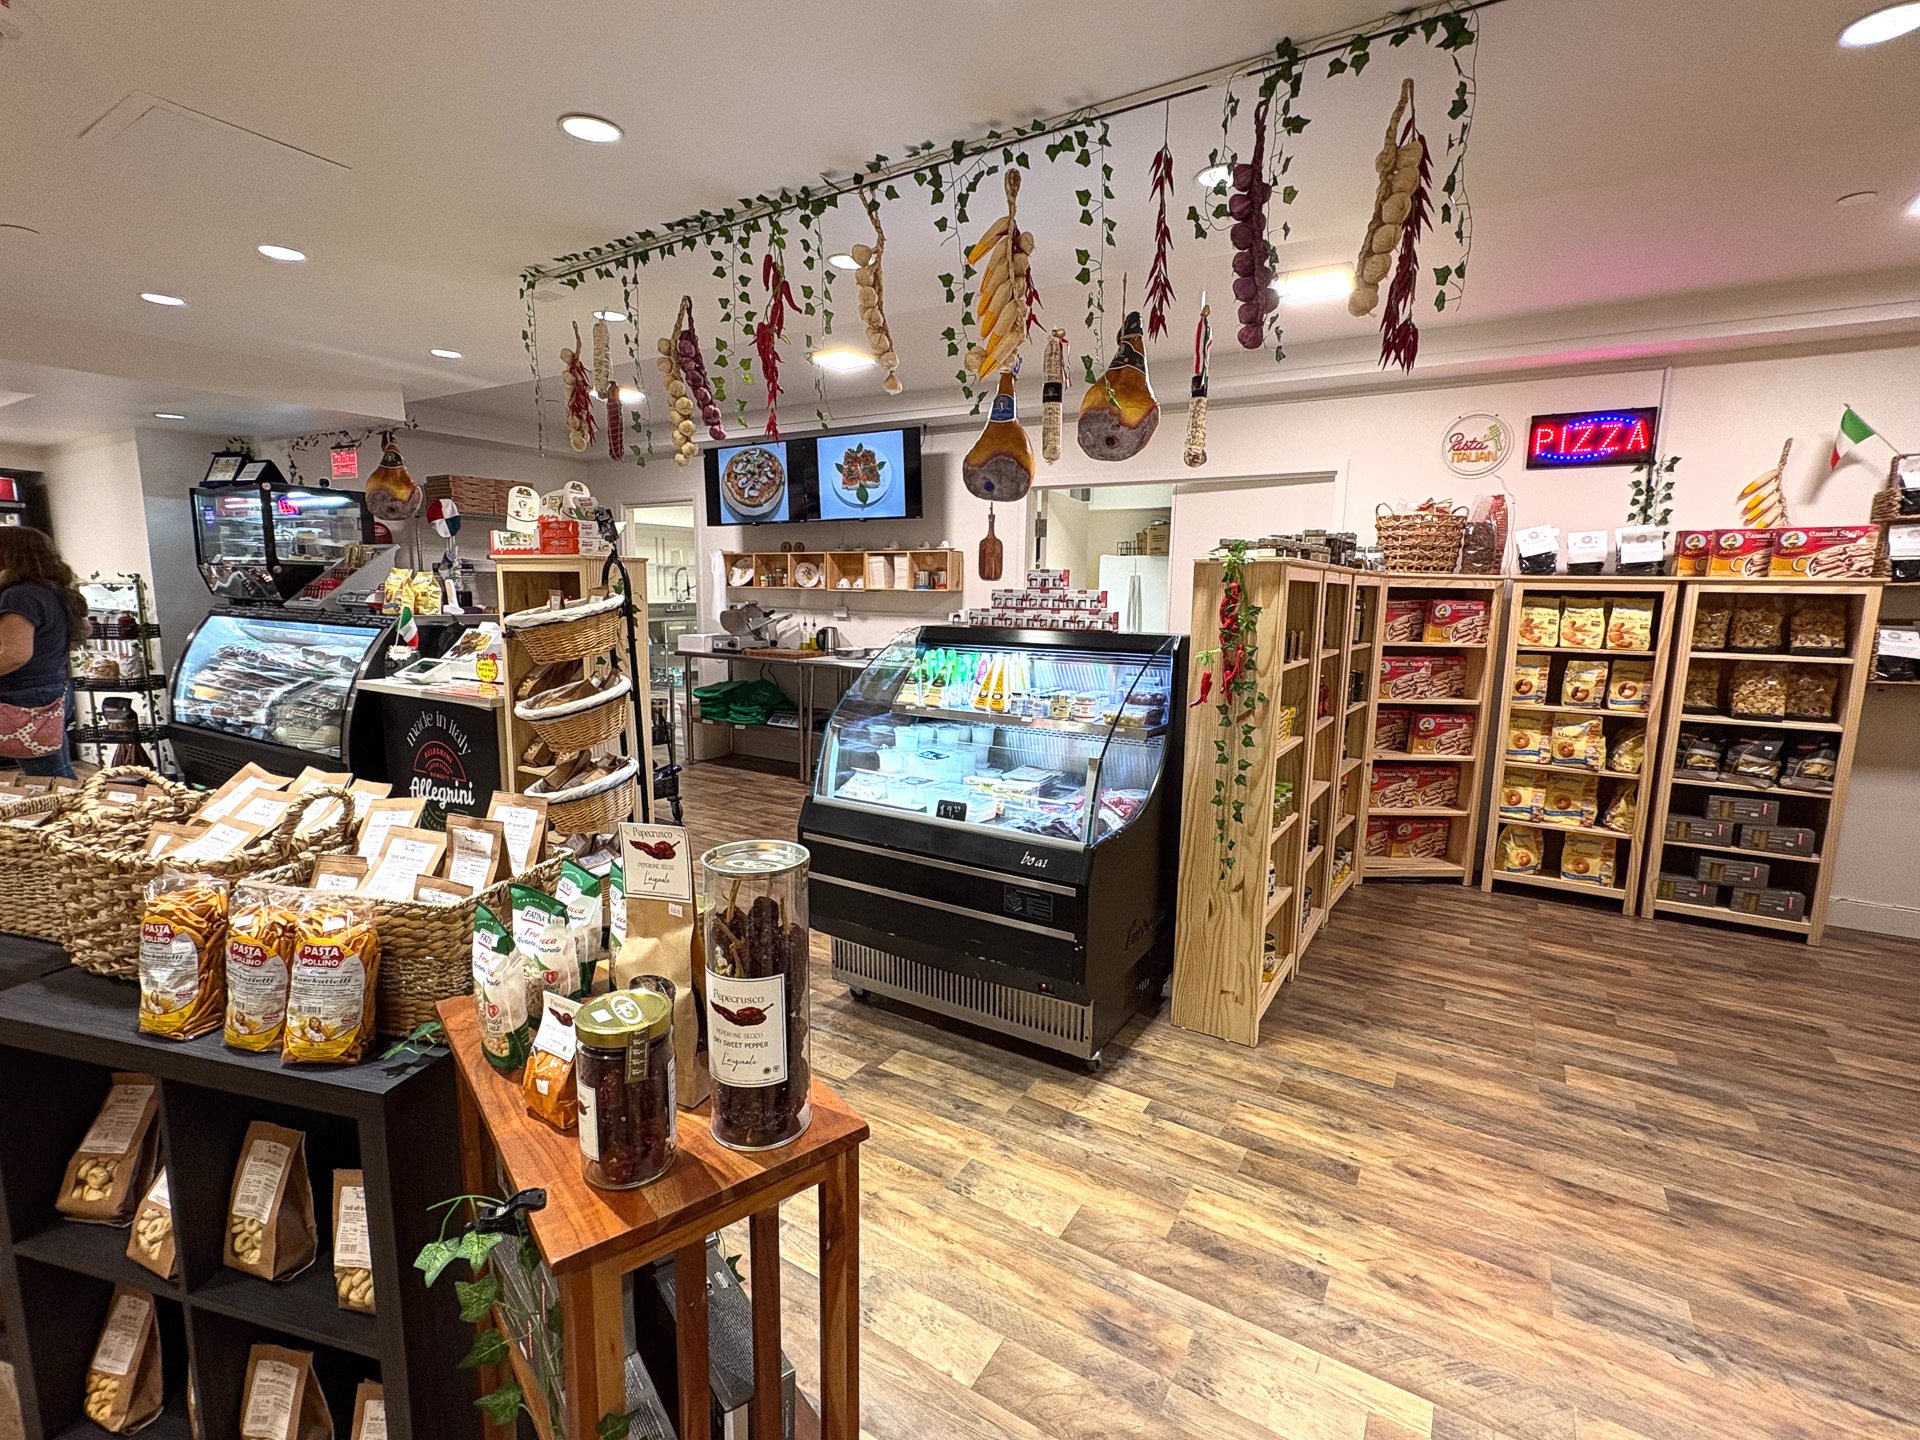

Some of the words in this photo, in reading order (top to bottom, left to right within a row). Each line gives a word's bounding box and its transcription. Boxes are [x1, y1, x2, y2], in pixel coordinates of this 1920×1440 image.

[1448, 432, 1490, 453] Pasta
[1535, 419, 1648, 454] PIZZA
[1451, 450, 1498, 463] ITALIAN
[406, 710, 433, 747] made
[436, 710, 446, 730] in
[448, 720, 471, 755] italy
[424, 748, 453, 764] ALLEGRINI
[409, 777, 475, 809] Allegrini
[632, 827, 672, 839] Pepecrusco
[525, 910, 545, 922] FATINA
[145, 924, 171, 934] PASTA
[144, 936, 170, 944] POLLINO
[480, 933, 492, 945] FATI
[233, 942, 262, 957] PASTA
[304, 946, 340, 956] PASTA
[232, 954, 262, 966] POLLINO
[302, 958, 339, 968] POLLINO
[713, 988, 764, 1004] Pepecrusco
[715, 1027, 742, 1039] PEPERONE
[713, 1036, 722, 1044] DRY
[723, 1040, 742, 1049] SWEET
